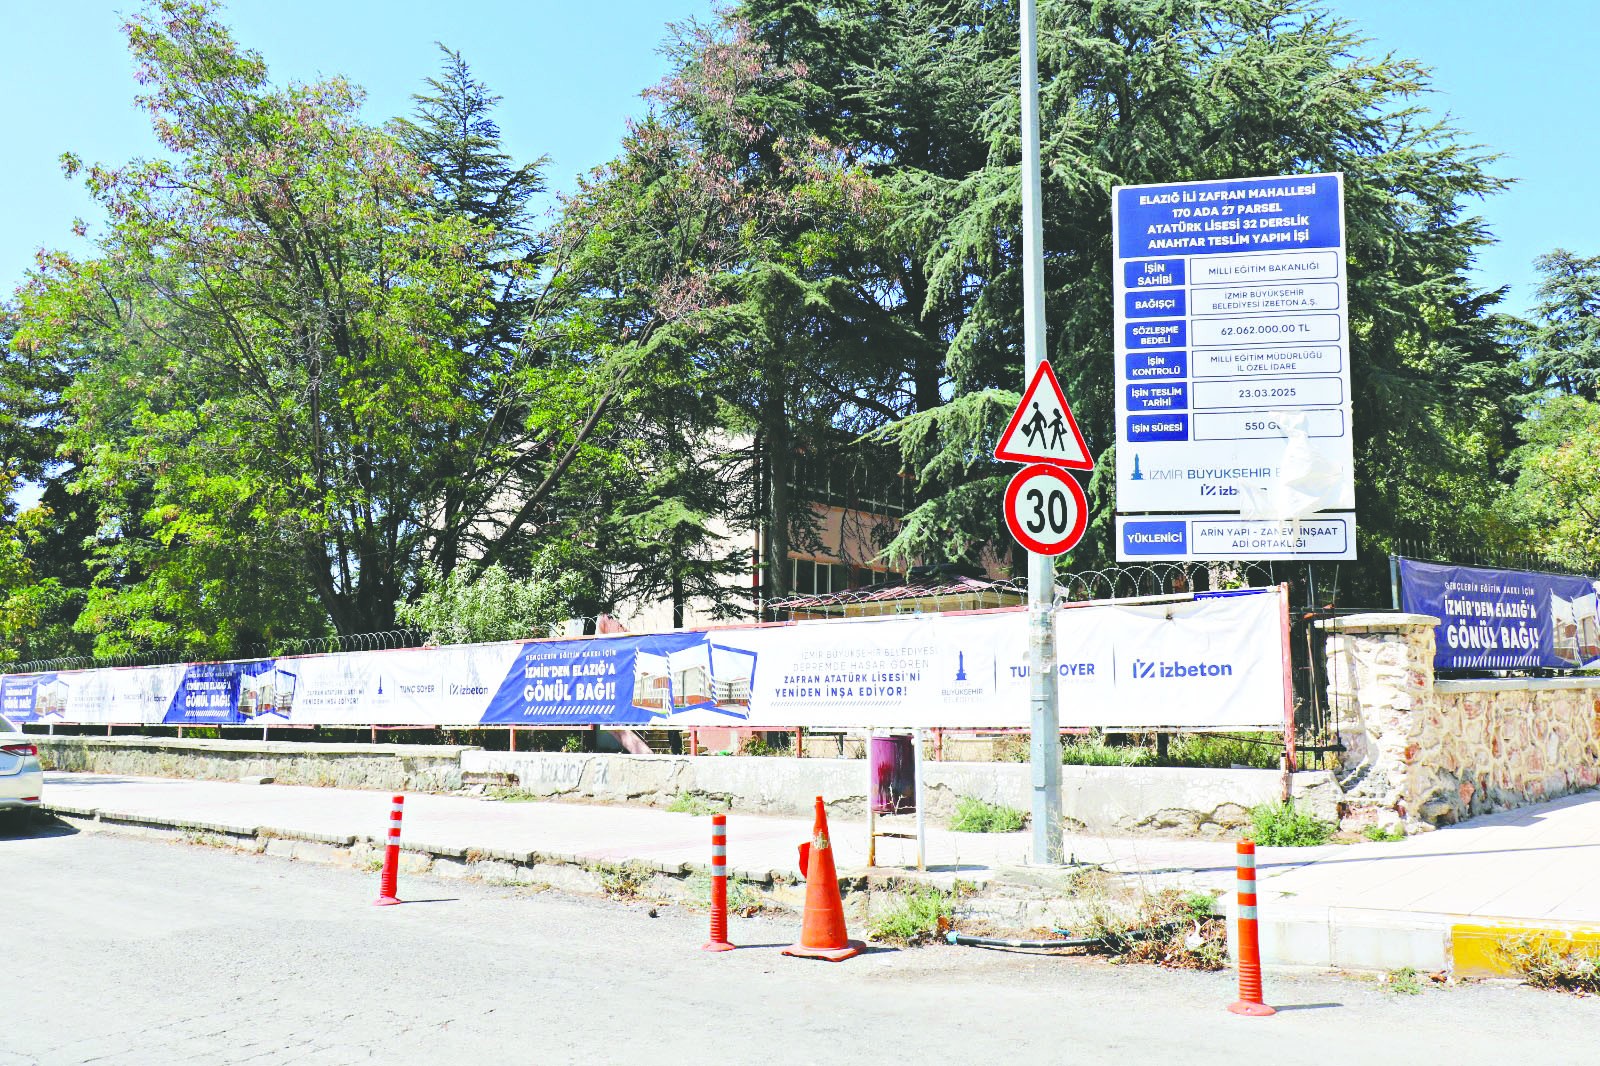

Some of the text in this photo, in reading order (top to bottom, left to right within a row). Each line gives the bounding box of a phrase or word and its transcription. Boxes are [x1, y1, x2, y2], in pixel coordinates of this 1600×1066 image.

[1139, 183, 1316, 205] ELAZIĞ İLİ ZAFRAN MAHALLESİ
[1172, 203, 1282, 218] 170 ADA 27 PARSEL
[1147, 215, 1309, 235] ATATÜRK LİSESİ 32 DERSLİK
[1148, 229, 1309, 249] ANAHTAR TESLİM YAPIM İŞİ
[1144, 262, 1165, 274] İŞİN
[1208, 262, 1320, 275] MİLLİ EĞİTİM BAKANLIĞI
[1137, 273, 1173, 286] SAHİBİ
[1225, 288, 1305, 300] İZMİR BÜYÜKŞEHİR
[1135, 297, 1175, 310] BAĞIŞÇI
[1212, 300, 1260, 310] BELEDİYESİ
[1132, 324, 1179, 336] SÖZLEŞME
[1298, 323, 1311, 333] TL
[1140, 334, 1171, 345] BEDELİ
[1147, 355, 1165, 367] İŞİN
[1210, 350, 1323, 363] MİLLİ EĞİTİM MÜDÜRLÜĞÜ
[1132, 364, 1181, 377] KONTROLÜ
[1270, 361, 1297, 370] İDARE
[1131, 385, 1182, 399] İŞİN TESLİM
[1239, 388, 1297, 399] 23.03.2025
[1142, 396, 1171, 408] TARİHİ
[1132, 421, 1183, 434] İŞİN SÜRESİ
[1245, 422, 1265, 431] 550
[1187, 467, 1271, 480] BÜYÜKŞEHİR
[1026, 488, 1068, 534] 30
[1127, 531, 1182, 544] YÜKLENİCİ
[1200, 527, 1224, 537] ARİN
[1227, 526, 1250, 537] YAPI
[1299, 525, 1338, 538] İNŞAAT
[1232, 537, 1306, 549] ADİ ORTAKLĞI
[1445, 581, 1478, 592] GENÇLERİN
[1445, 596, 1537, 618] İZMİR'DEN ELAZIĞ'A
[1447, 620, 1539, 649] GÖNÜL BAĞI!
[525, 659, 616, 679] İZMİR'DEN ELAZIĞ'A
[850, 660, 886, 670] HASAR
[1056, 663, 1095, 677] OYER
[1160, 661, 1232, 678] izbeton
[784, 671, 921, 684] ZAFRAN ATATÜRK LİSESİ'Nİ
[459, 685, 489, 696] izbeton
[523, 677, 616, 702] GÖNÜL BAĞI!
[775, 684, 908, 698] YENİDEN İNŞA EDİYOR!
